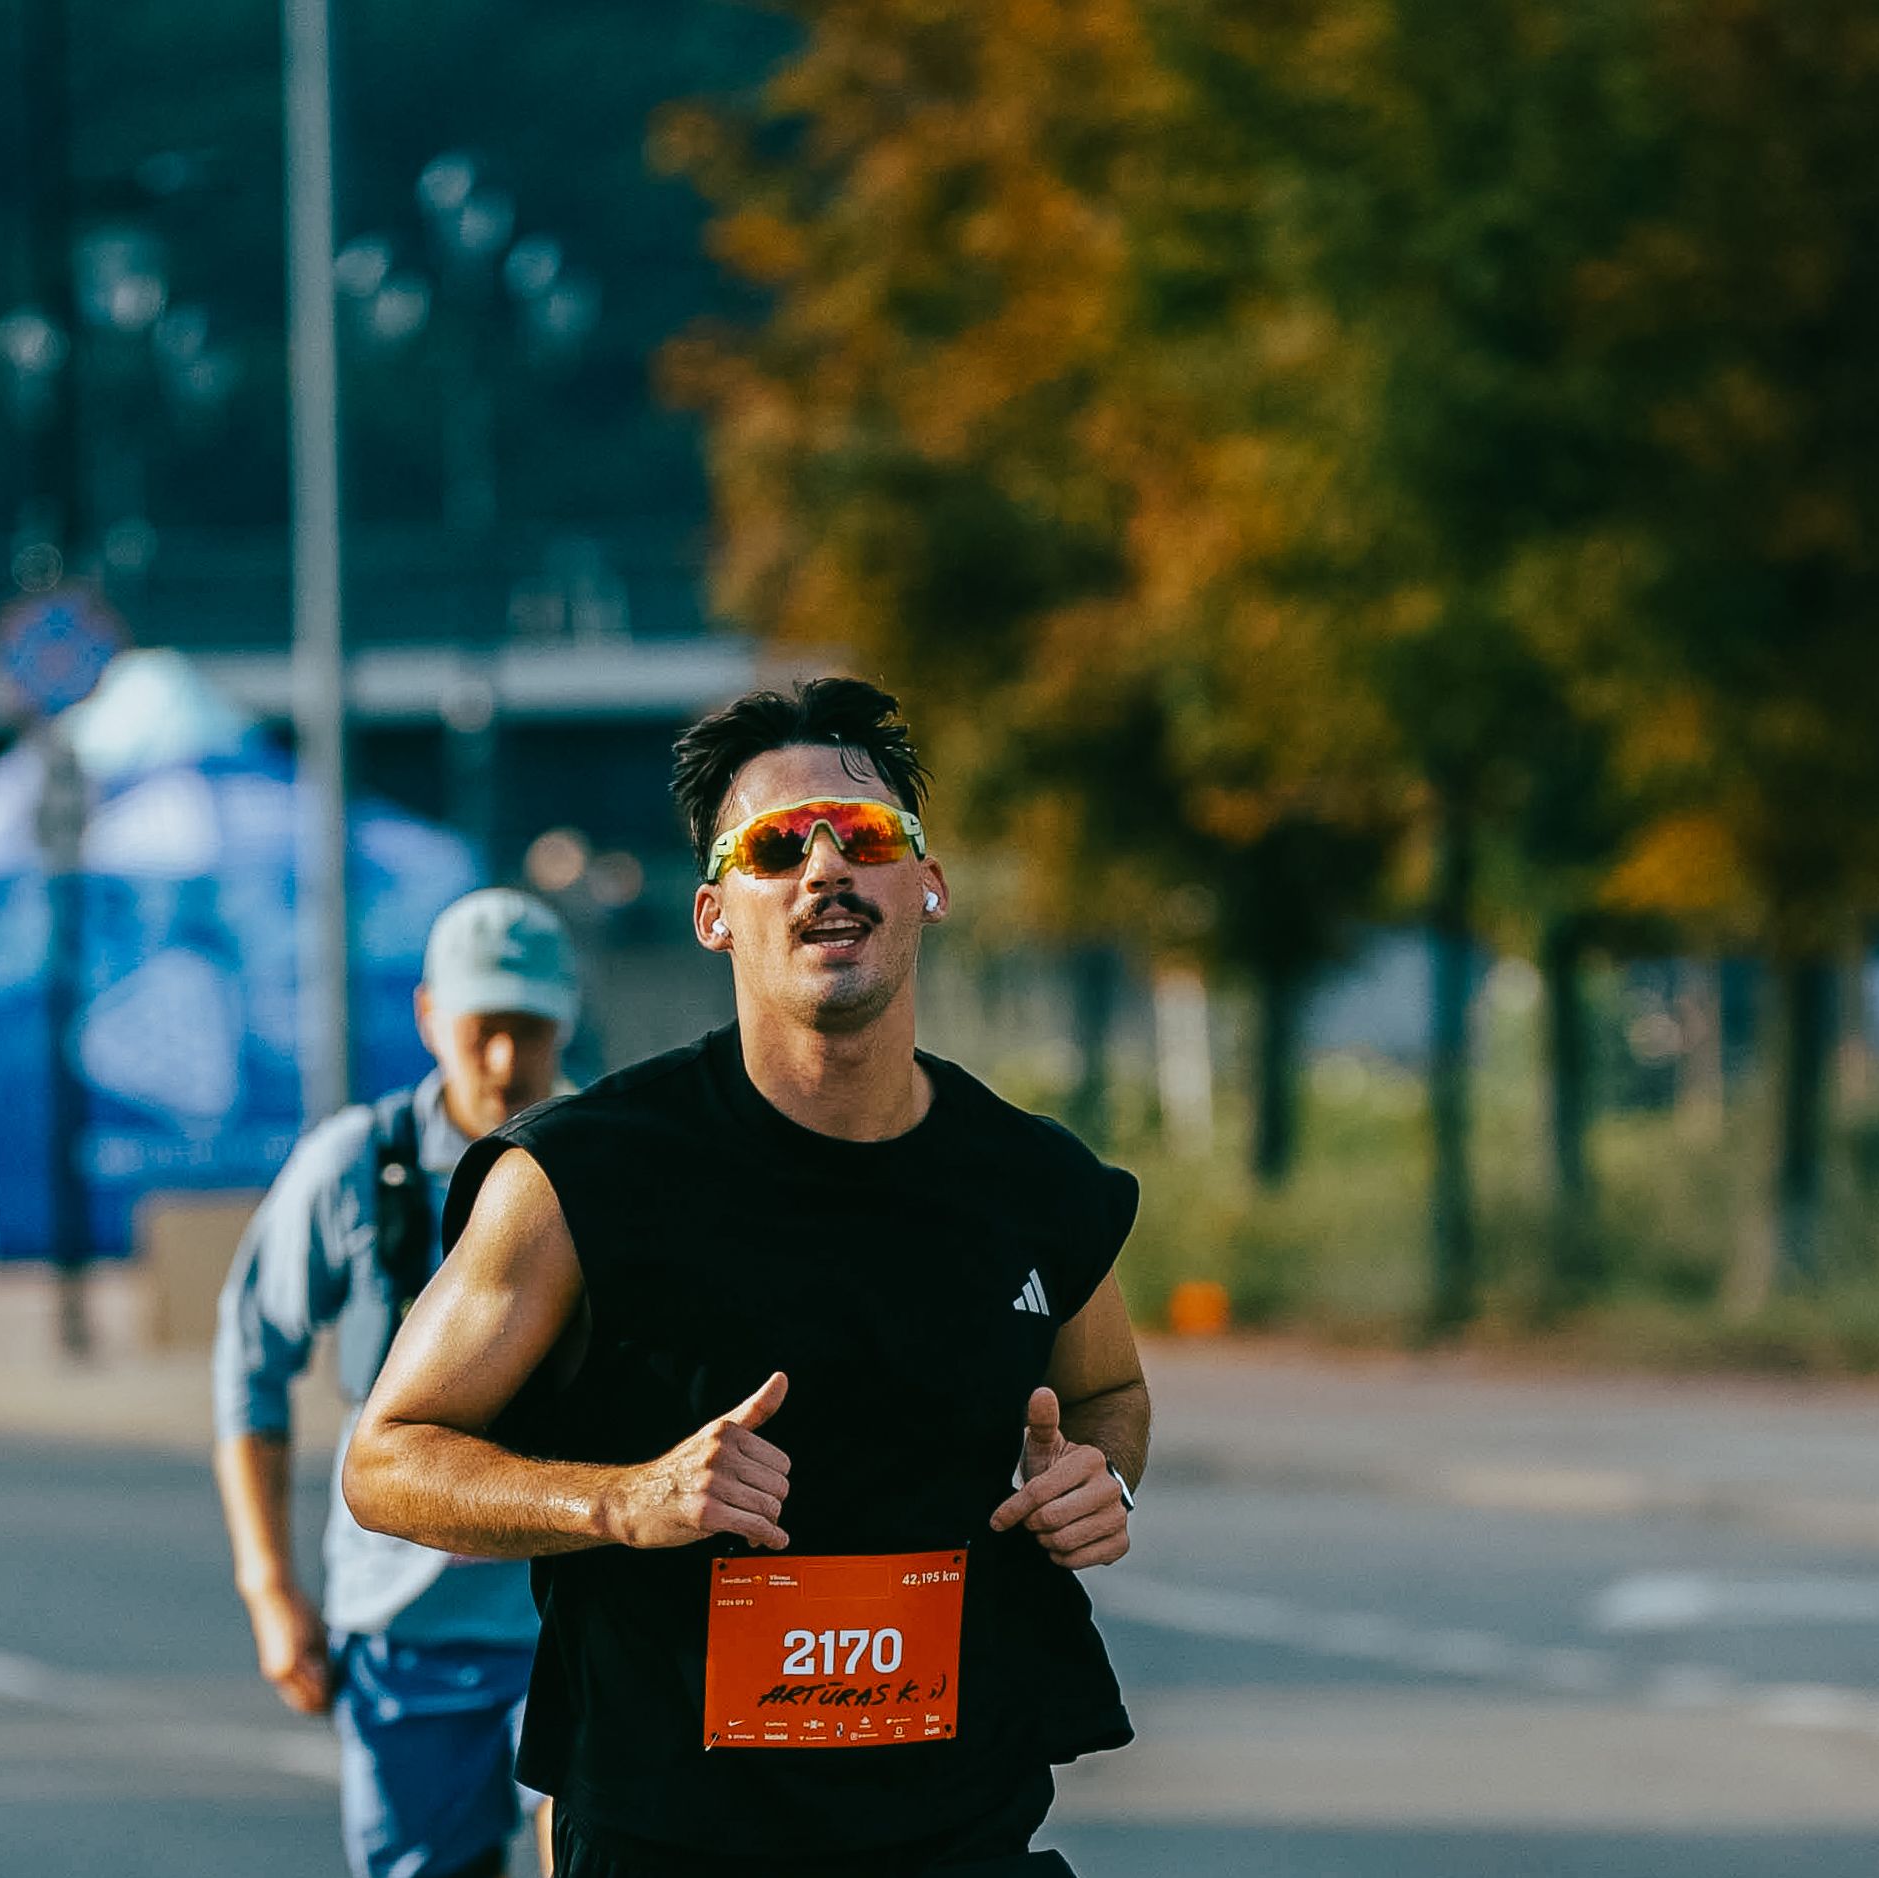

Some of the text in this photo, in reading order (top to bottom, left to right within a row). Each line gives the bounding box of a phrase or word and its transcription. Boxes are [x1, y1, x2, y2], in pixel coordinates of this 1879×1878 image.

[942, 1570, 960, 1582] km
[782, 1627, 903, 1675] 2170
[757, 1681, 891, 1707] ARTŪRAS
[896, 1679, 920, 1704] K.
